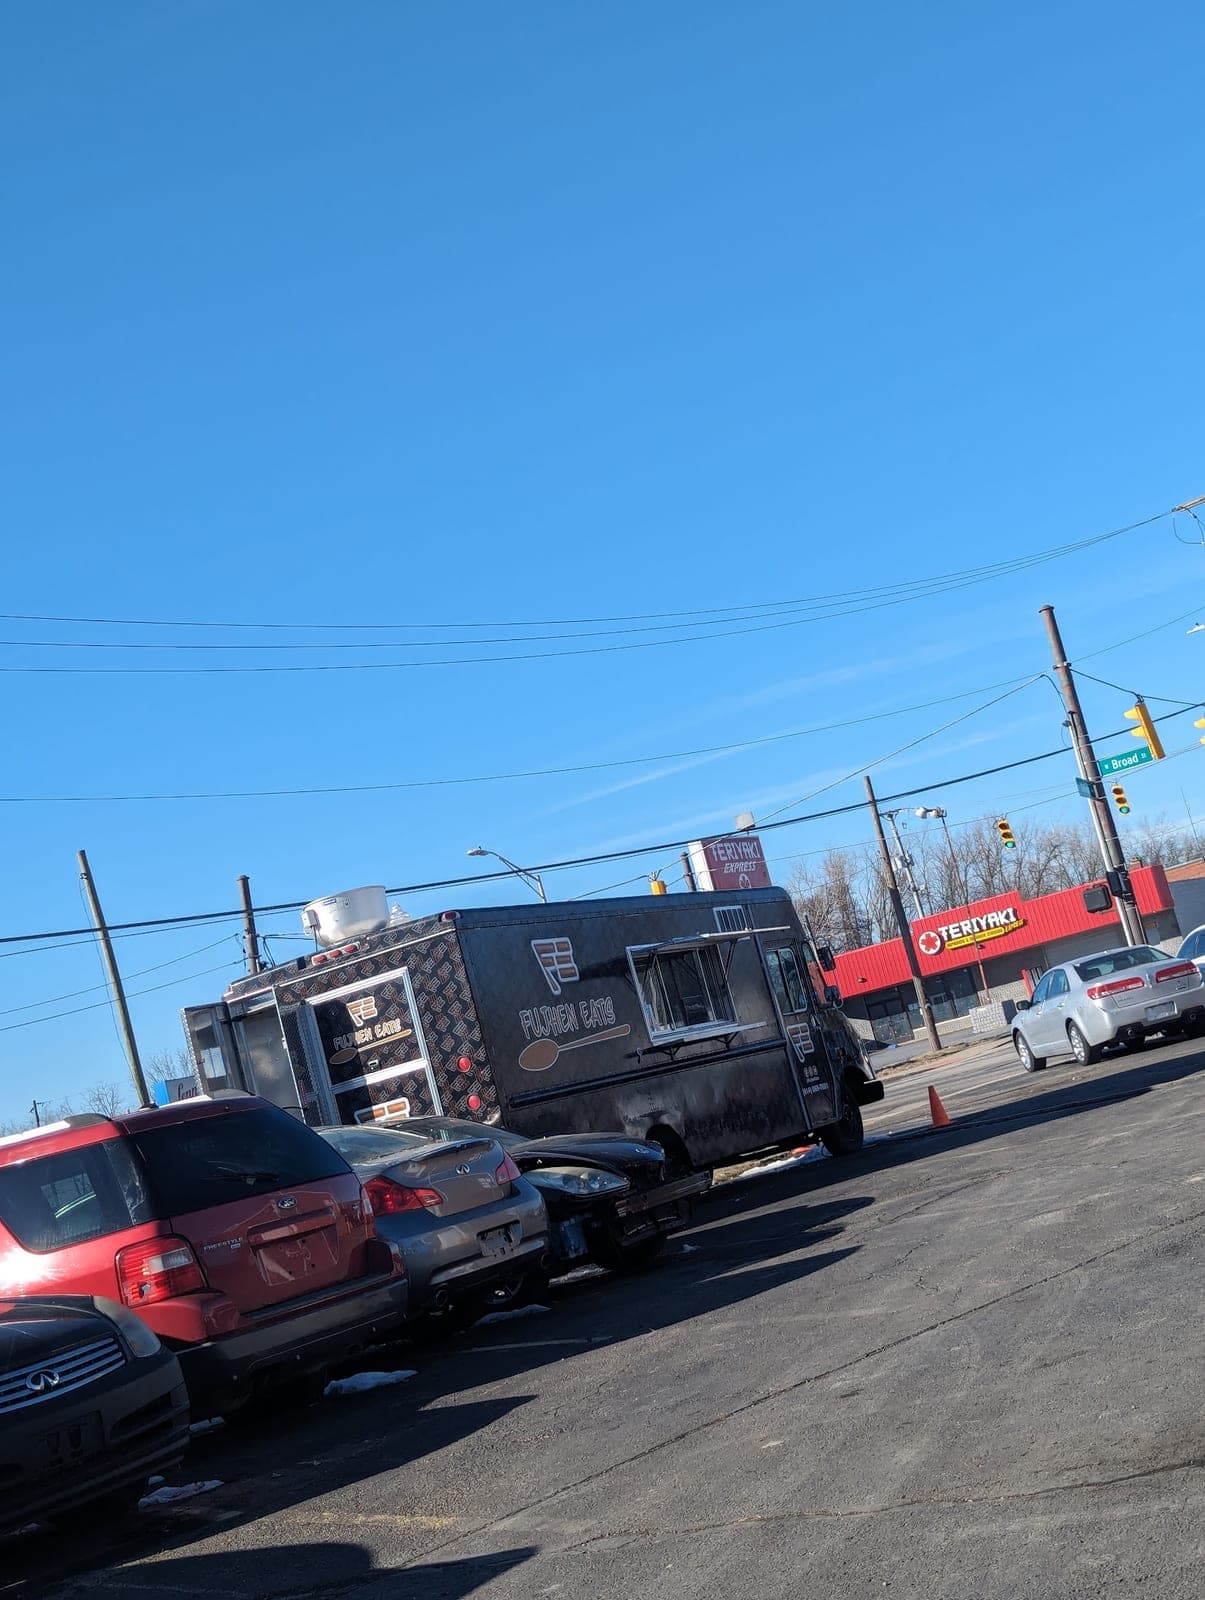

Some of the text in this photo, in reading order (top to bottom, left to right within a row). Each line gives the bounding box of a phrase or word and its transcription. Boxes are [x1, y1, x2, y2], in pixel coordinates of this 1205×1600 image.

[1111, 753, 1139, 770] Broad
[709, 841, 761, 861] TERIYAKI
[723, 861, 757, 874] EXPRESS
[938, 907, 1018, 940] TERIYAKI
[580, 996, 616, 1029] EATS
